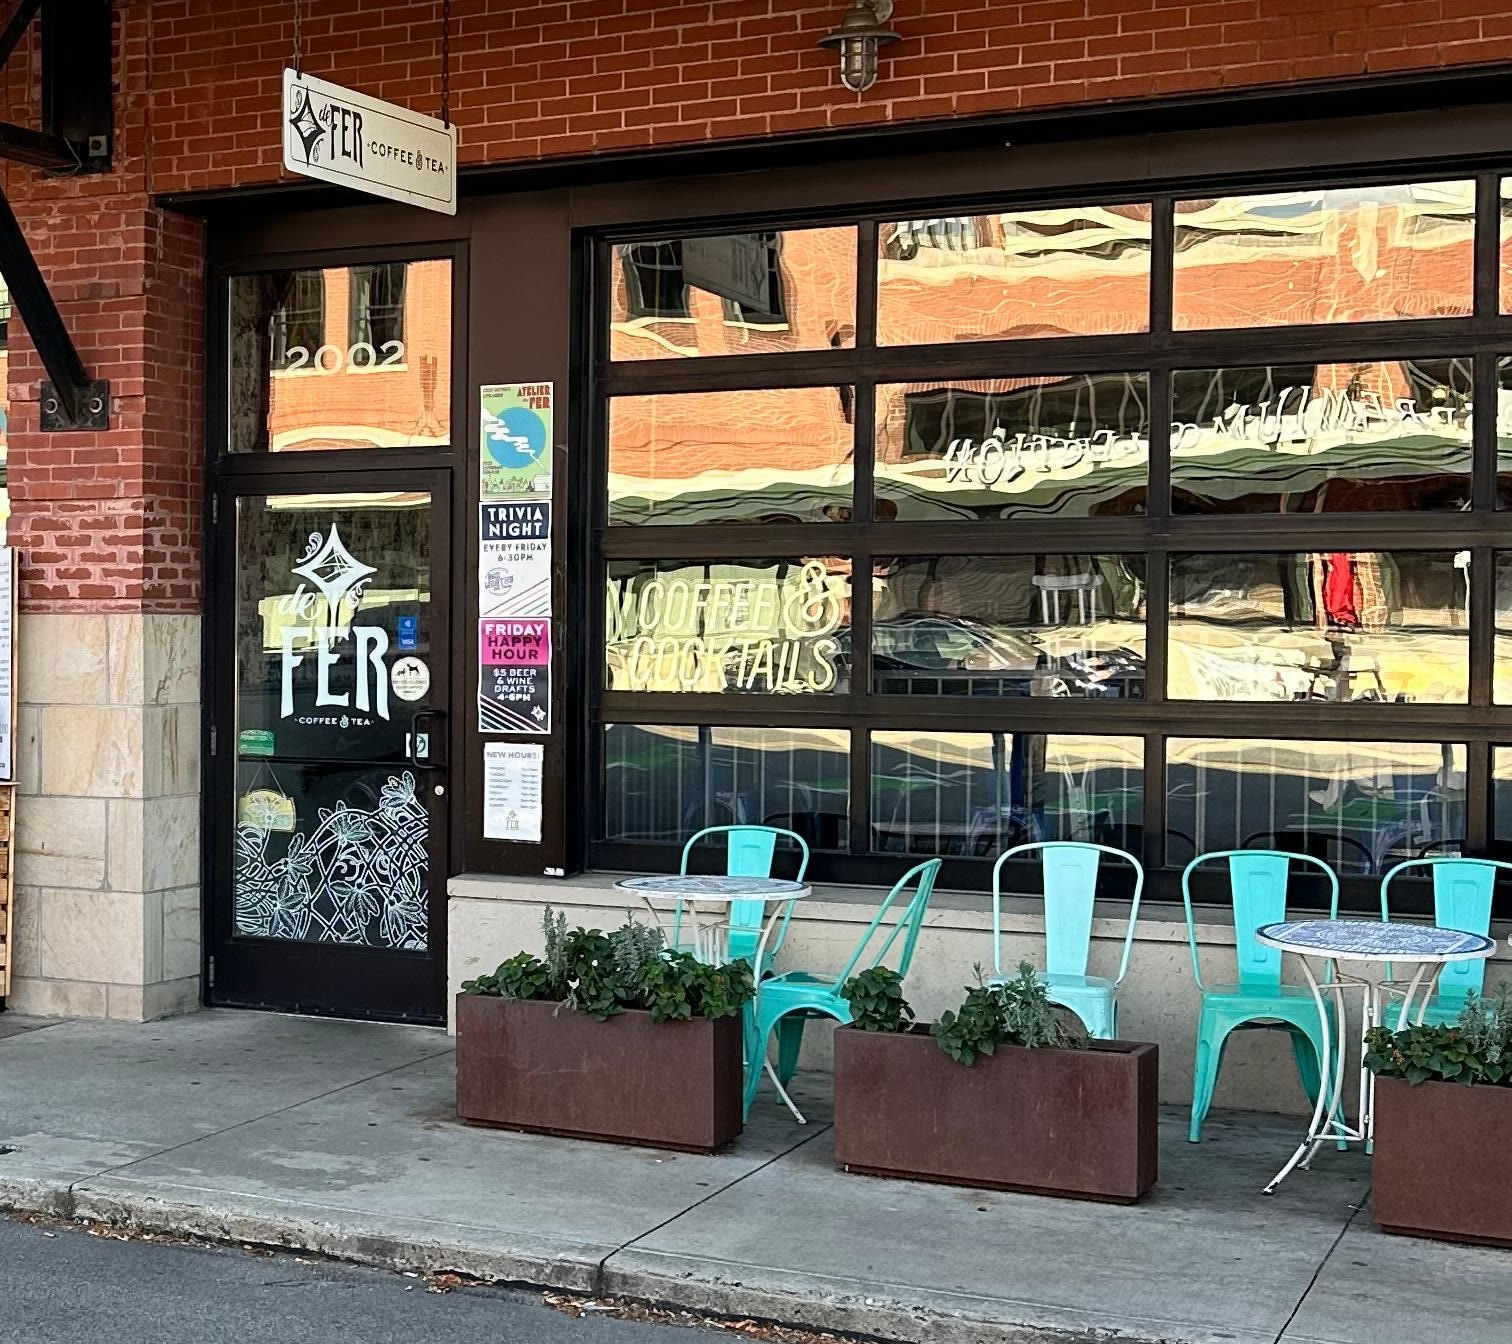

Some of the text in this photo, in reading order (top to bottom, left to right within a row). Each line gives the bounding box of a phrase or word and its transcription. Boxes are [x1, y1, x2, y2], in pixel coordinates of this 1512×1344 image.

[330, 104, 363, 170] FER
[371, 140, 413, 165] COFFEE
[425, 156, 445, 174] TEA
[284, 340, 405, 376] 2002
[517, 385, 550, 397] ATELIER
[529, 396, 550, 409] FER
[487, 507, 543, 522] TRIVIA
[488, 522, 542, 537] NIGHT
[483, 542, 547, 553] EVERY FRIDAY
[277, 583, 321, 621] de
[638, 580, 778, 632] COFFEE
[485, 623, 544, 636] FRIDAY
[488, 636, 542, 647] HAPPY
[492, 649, 538, 660] HOUR
[630, 636, 837, 692] COCKTAILS
[279, 625, 390, 721] FER
[509, 668, 537, 677] BEER
[506, 677, 533, 685] WINE
[494, 685, 536, 693] DRAFTS
[496, 693, 531, 702] 4-6PM
[298, 717, 337, 726] COFFEE
[350, 717, 371, 726] TEA
[486, 751, 507, 759] NEW
